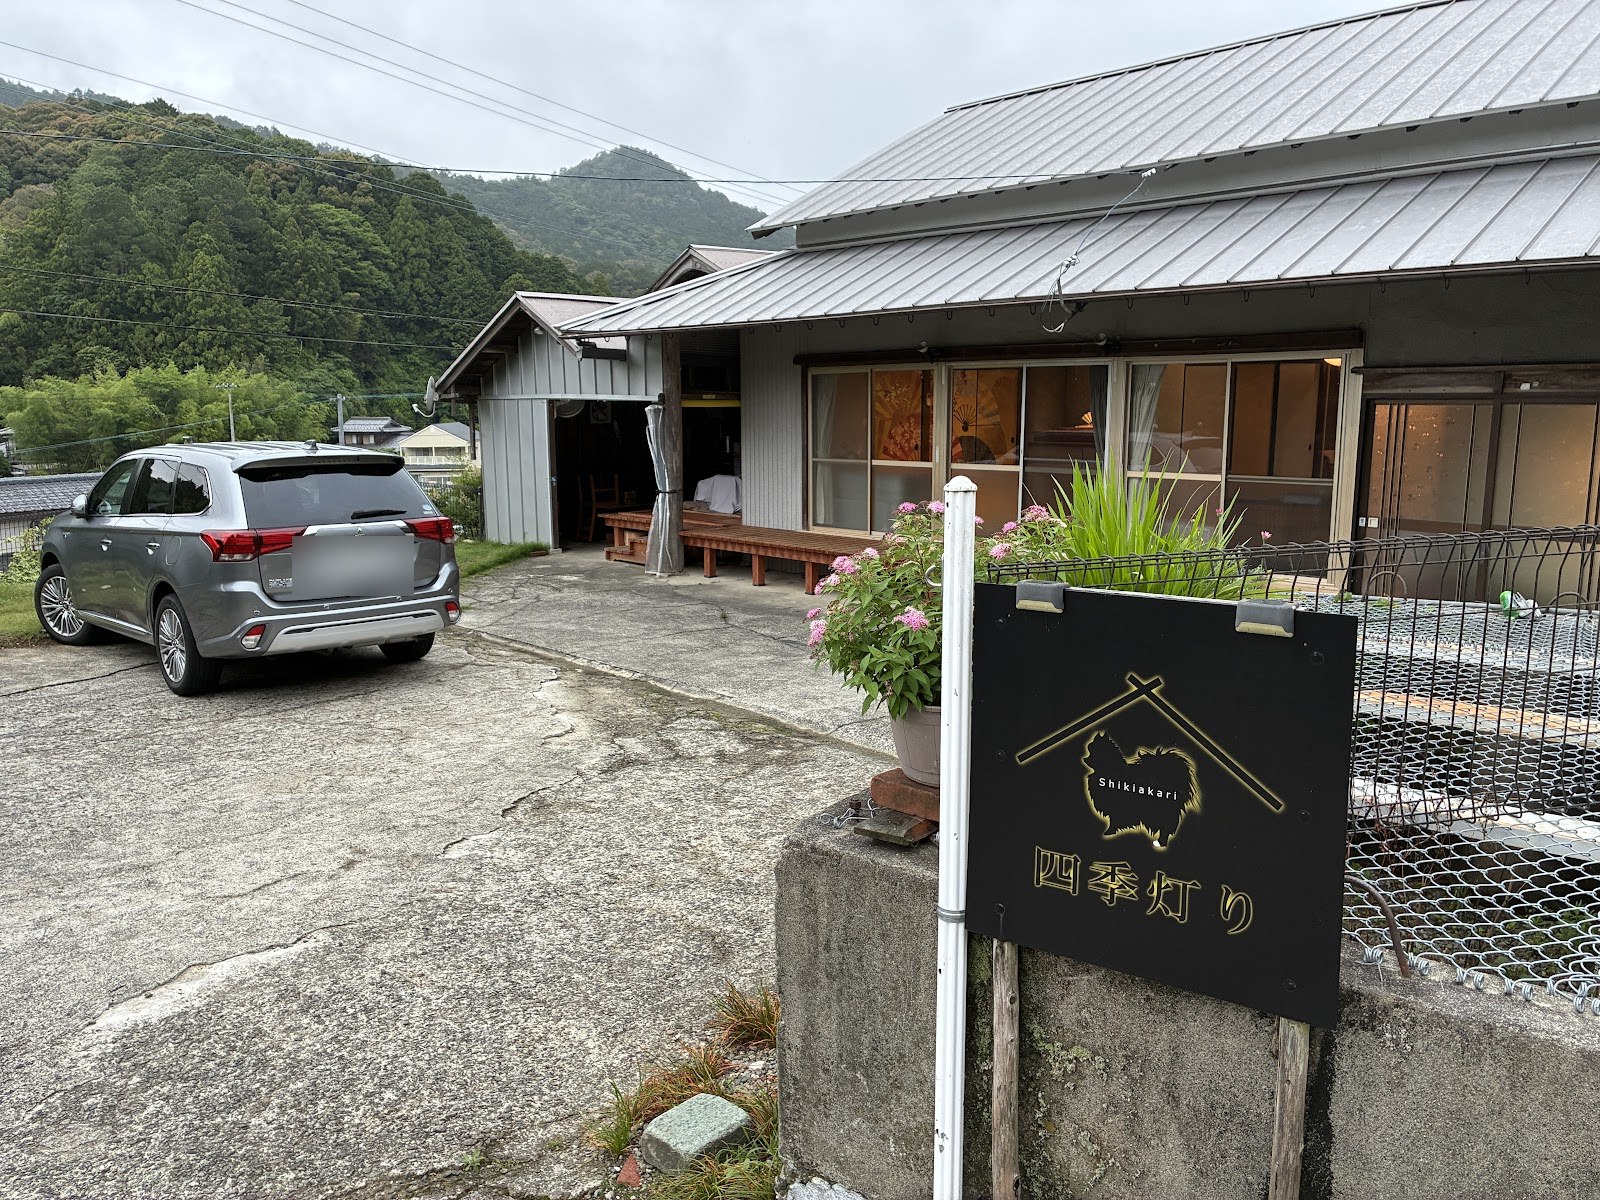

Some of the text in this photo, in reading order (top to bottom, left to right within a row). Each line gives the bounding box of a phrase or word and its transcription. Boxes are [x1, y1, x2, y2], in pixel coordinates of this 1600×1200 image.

[1098, 777, 1178, 801] Shikiakari
[1034, 845, 1254, 935] 四季灯り
